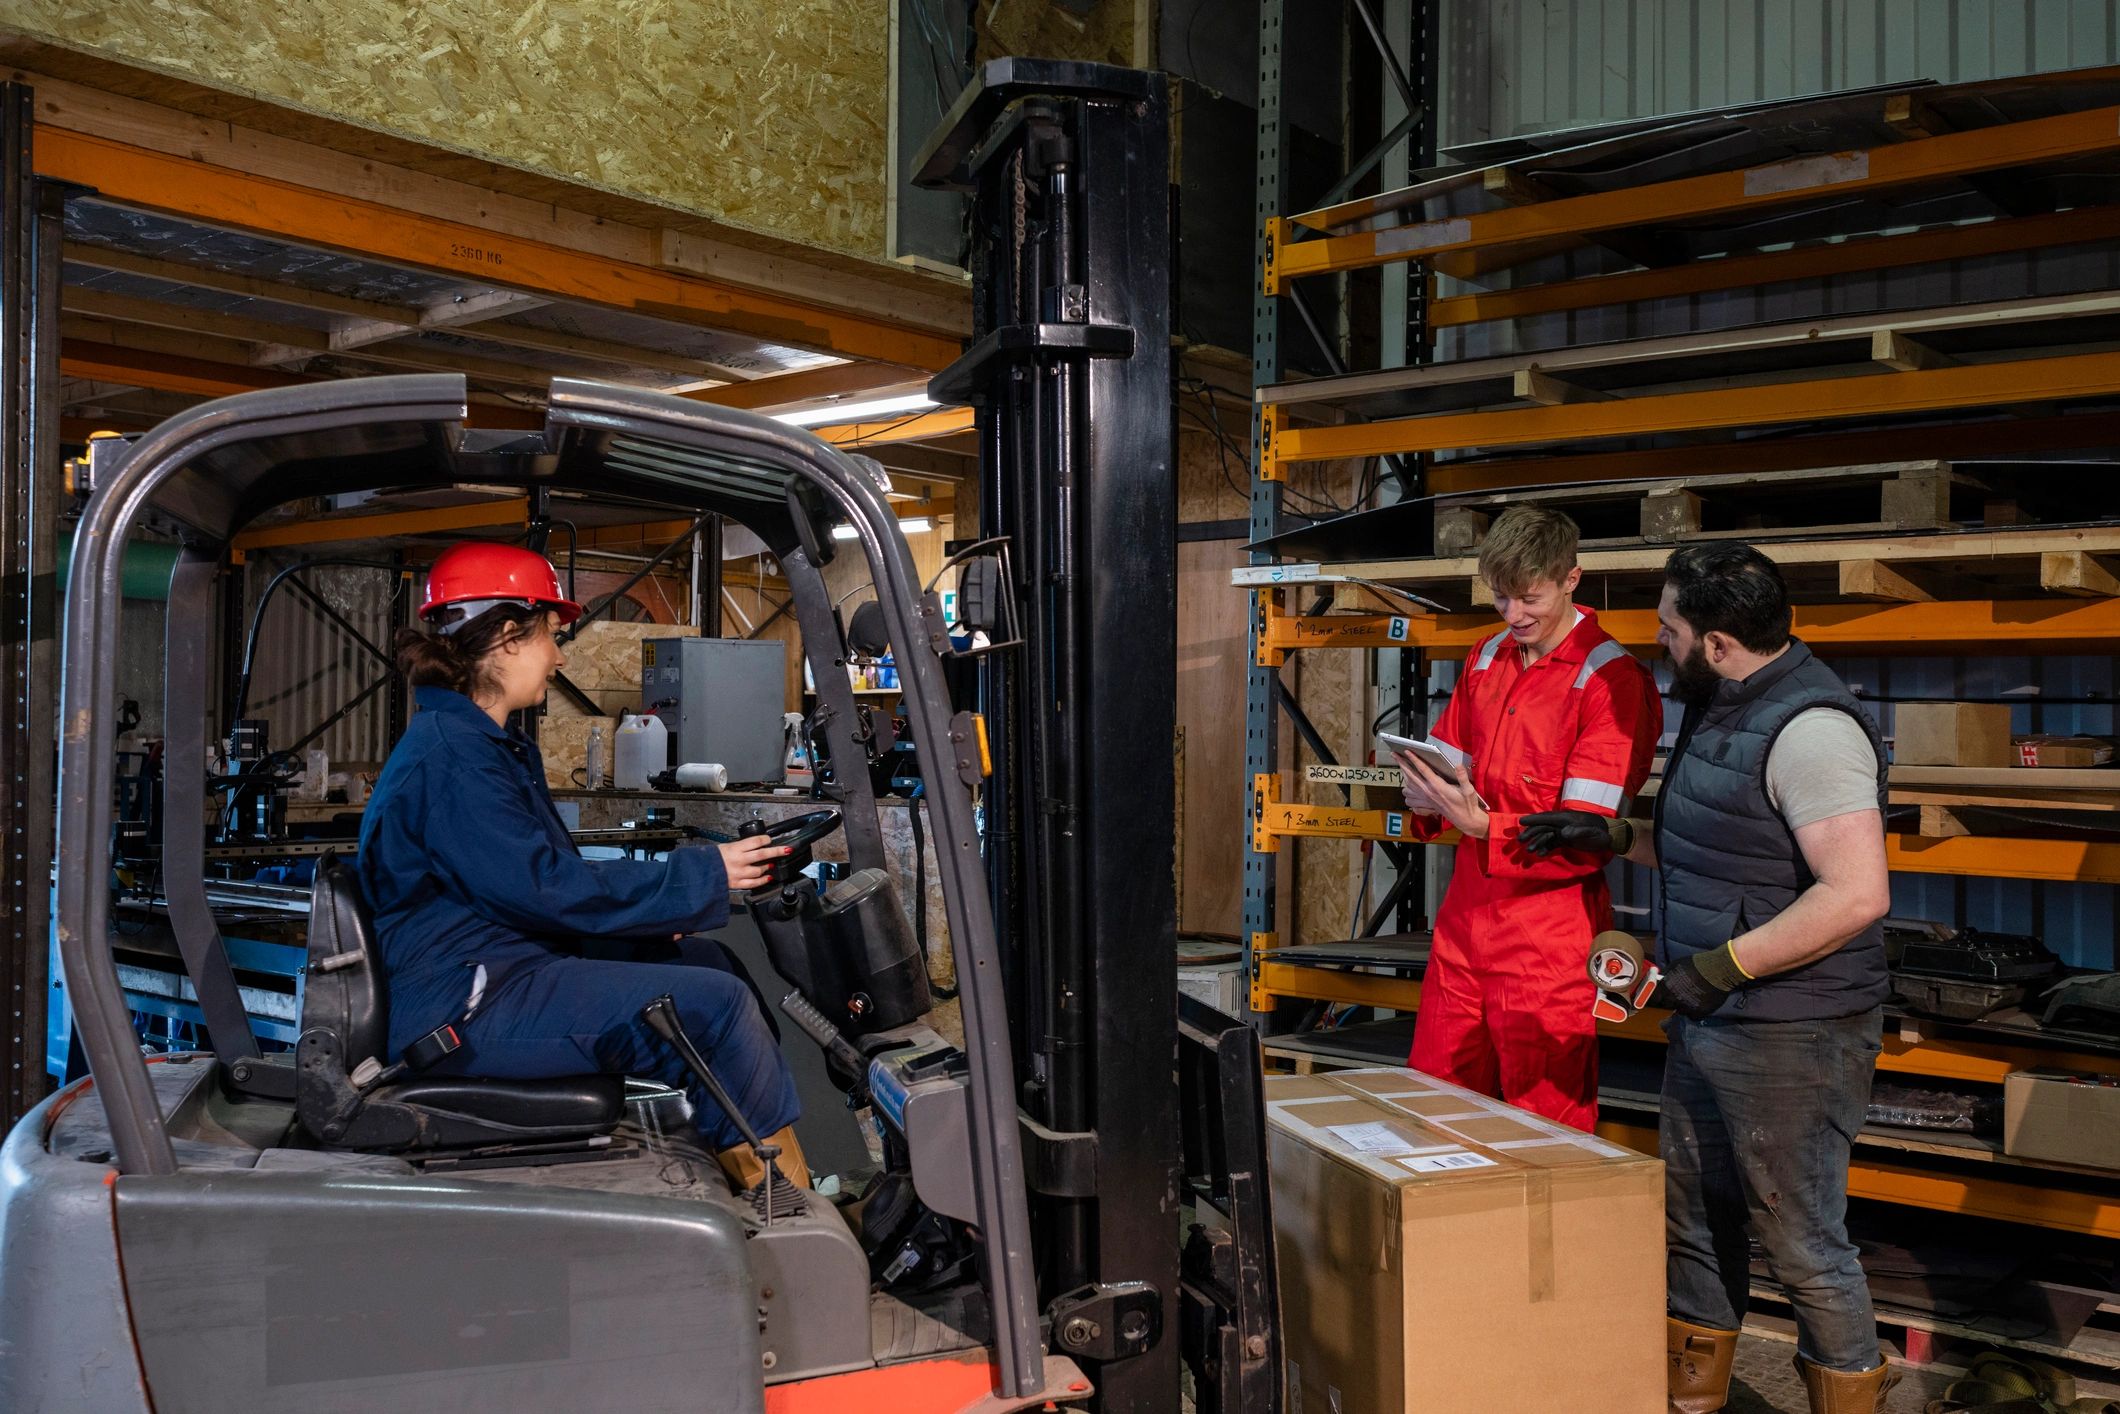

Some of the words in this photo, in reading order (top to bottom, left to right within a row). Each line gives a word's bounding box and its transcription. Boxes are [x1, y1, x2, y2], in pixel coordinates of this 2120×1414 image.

[451, 243, 483, 261] 2360
[1340, 624, 1376, 635] STEEL
[1391, 619, 1403, 638] B
[1296, 813, 1320, 826] 3mm
[1325, 816, 1362, 828] STEEL
[1388, 816, 1401, 835] E
